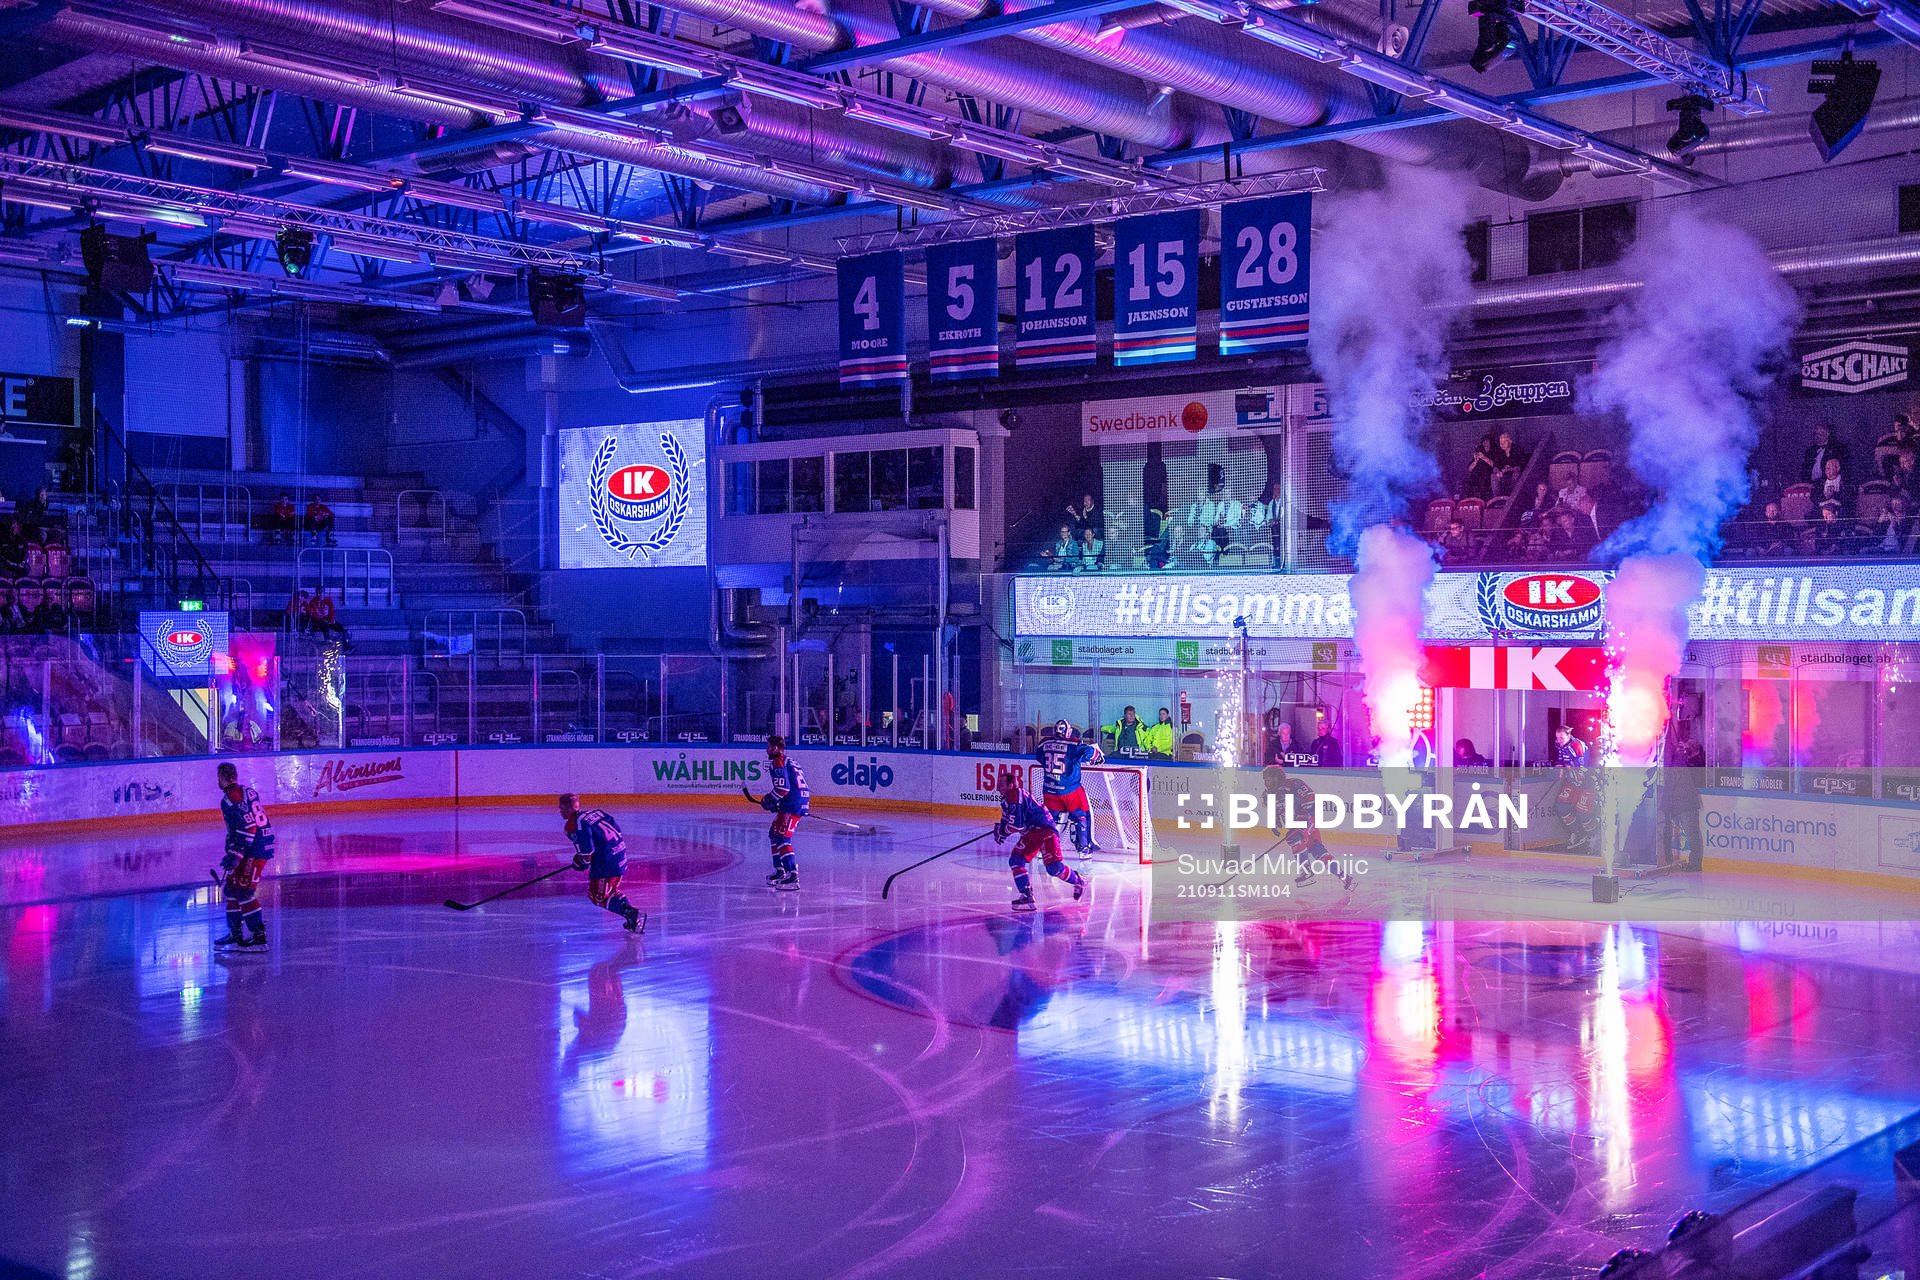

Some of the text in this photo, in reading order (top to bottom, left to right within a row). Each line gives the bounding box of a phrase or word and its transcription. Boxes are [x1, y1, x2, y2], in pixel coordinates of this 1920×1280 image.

[1236, 221, 1298, 289] 28
[1024, 253, 1083, 312] 12
[1129, 240, 1186, 301] 15
[853, 275, 880, 331] 4
[946, 264, 975, 321] 5
[1226, 293, 1308, 311] GUSTAFSSON
[1021, 315, 1088, 333] JOHANSSON
[1128, 307, 1189, 325] JAENSSON
[851, 338, 888, 350] MOORE
[938, 327, 982, 341] EKROTH
[1802, 352, 1908, 382] ÖSTSCHAKT
[1089, 410, 1178, 432] Swedbank
[623, 470, 655, 495] IK
[609, 494, 669, 519] OSKARSHAMN
[1529, 579, 1577, 604] IK
[1506, 605, 1599, 629] OSKARSHAMN
[1078, 645, 1135, 655] stadbolaget ab
[1256, 648, 1267, 656] ab
[1800, 653, 1892, 665] stadbolaget ab
[1469, 646, 1577, 691] IK
[652, 752, 762, 781] WÅHLINS
[831, 756, 894, 792] elajo
[1044, 752, 1066, 775] 35
[1152, 775, 1190, 793] fritid
[1760, 776, 1783, 790] MÖBLER
[1705, 811, 1837, 837] Oskarshamns
[1705, 830, 1795, 853] kommun
